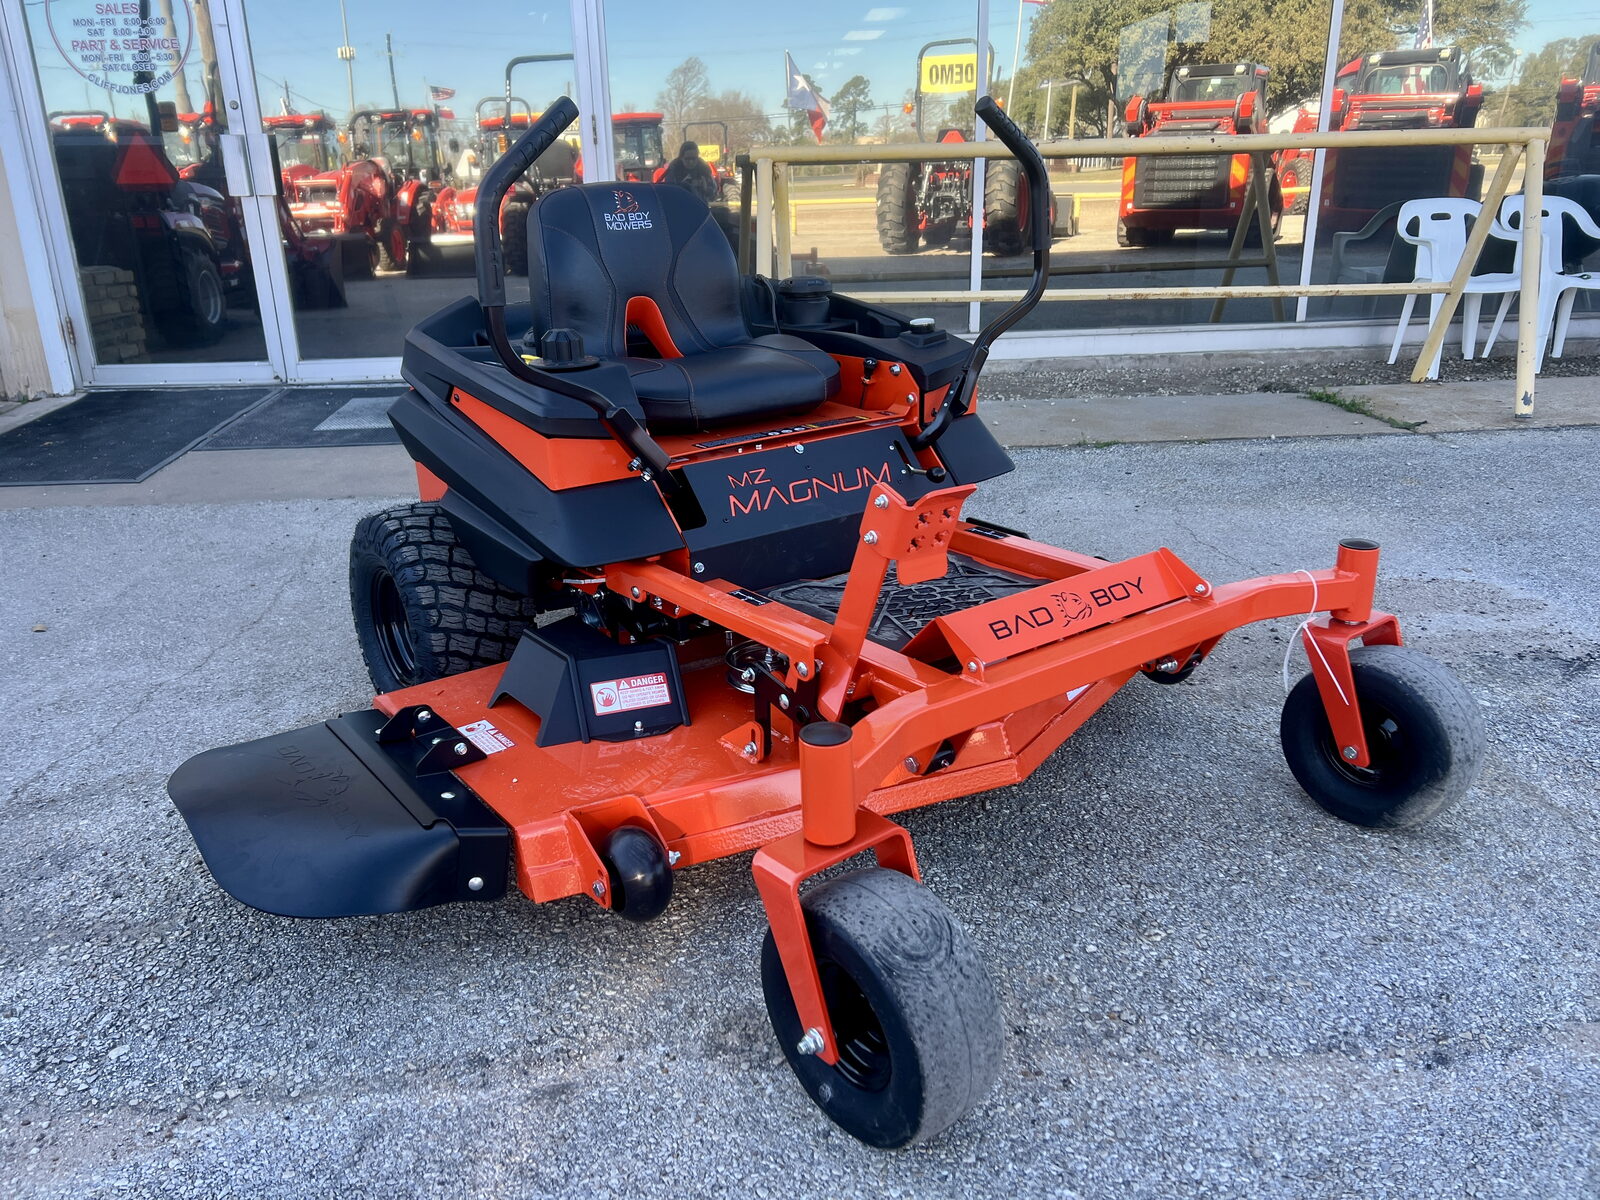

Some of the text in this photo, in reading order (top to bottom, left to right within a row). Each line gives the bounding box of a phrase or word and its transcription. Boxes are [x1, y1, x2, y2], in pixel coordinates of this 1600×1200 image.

[95, 3, 140, 15] SALES
[87, 28, 105, 37] SAT
[71, 38, 180, 52] PART & SERVICE
[102, 63, 158, 72] SAT CLOSED
[87, 70, 173, 95] CLIFFJONES.COM
[604, 211, 650, 222] BAD BOY
[606, 219, 652, 231] MOWERS
[727, 467, 771, 489] MZ
[728, 461, 893, 517] MAGNUM
[988, 576, 1145, 640] BAD BOY
[630, 675, 664, 687] DANGER
